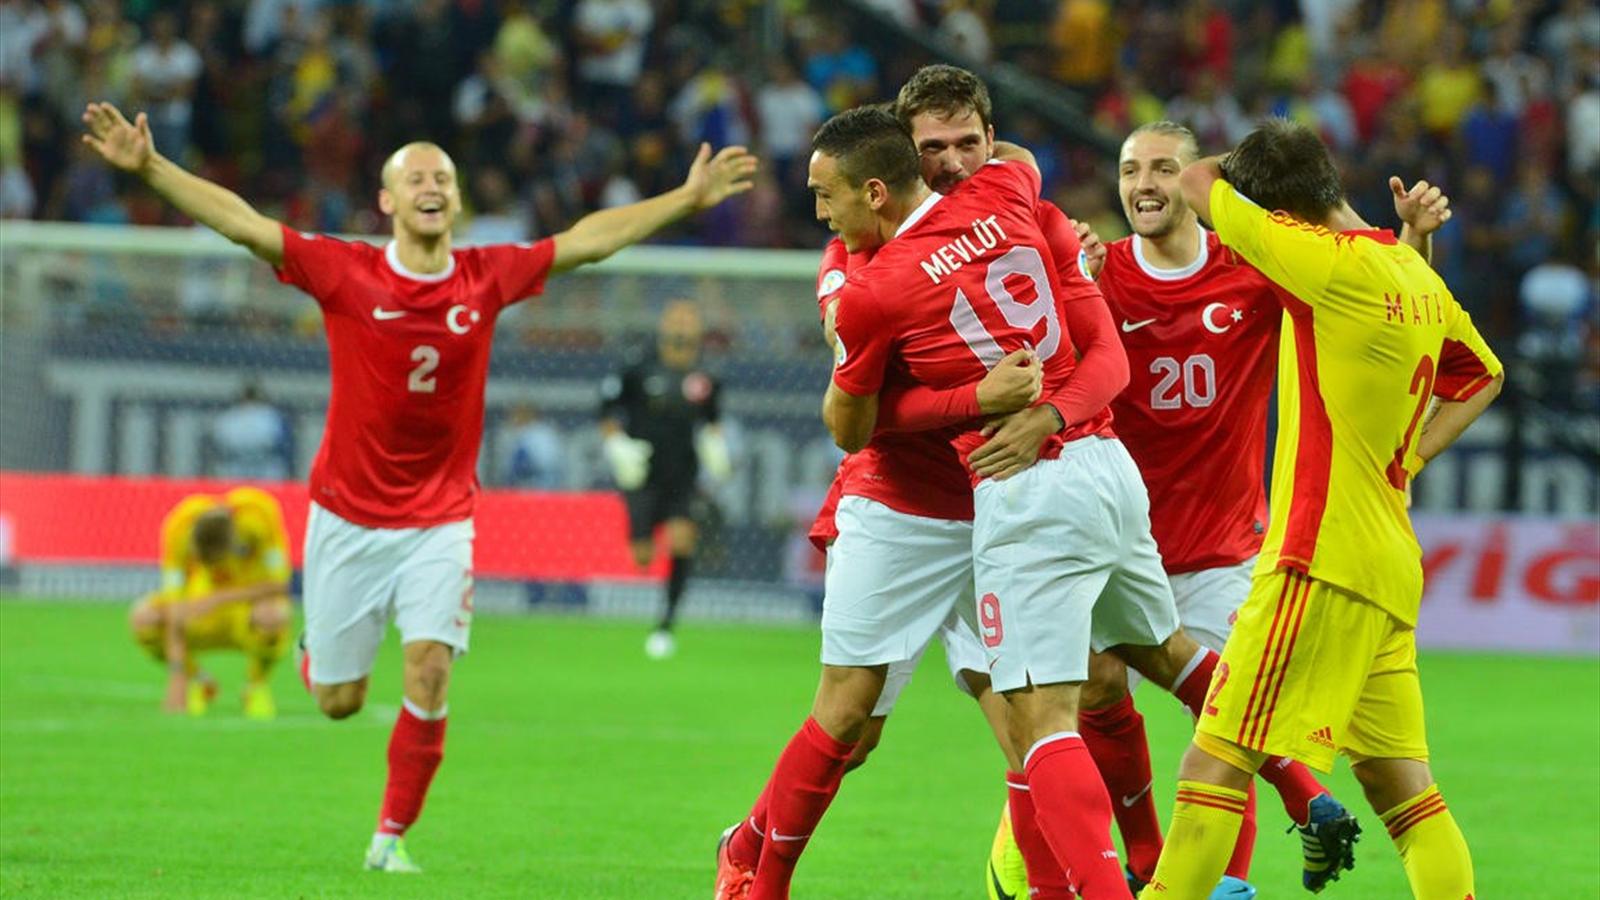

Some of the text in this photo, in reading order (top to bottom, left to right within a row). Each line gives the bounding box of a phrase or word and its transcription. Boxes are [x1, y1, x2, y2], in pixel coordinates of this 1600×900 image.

[920, 214, 1007, 285] MEVLÜT
[949, 245, 1061, 372] 19
[407, 345, 439, 393] 2
[1149, 353, 1217, 410] 20
[1385, 354, 1434, 491] 2
[980, 591, 1004, 648] 9
[1204, 661, 1231, 717] 2
[1305, 734, 1336, 749] adidas
